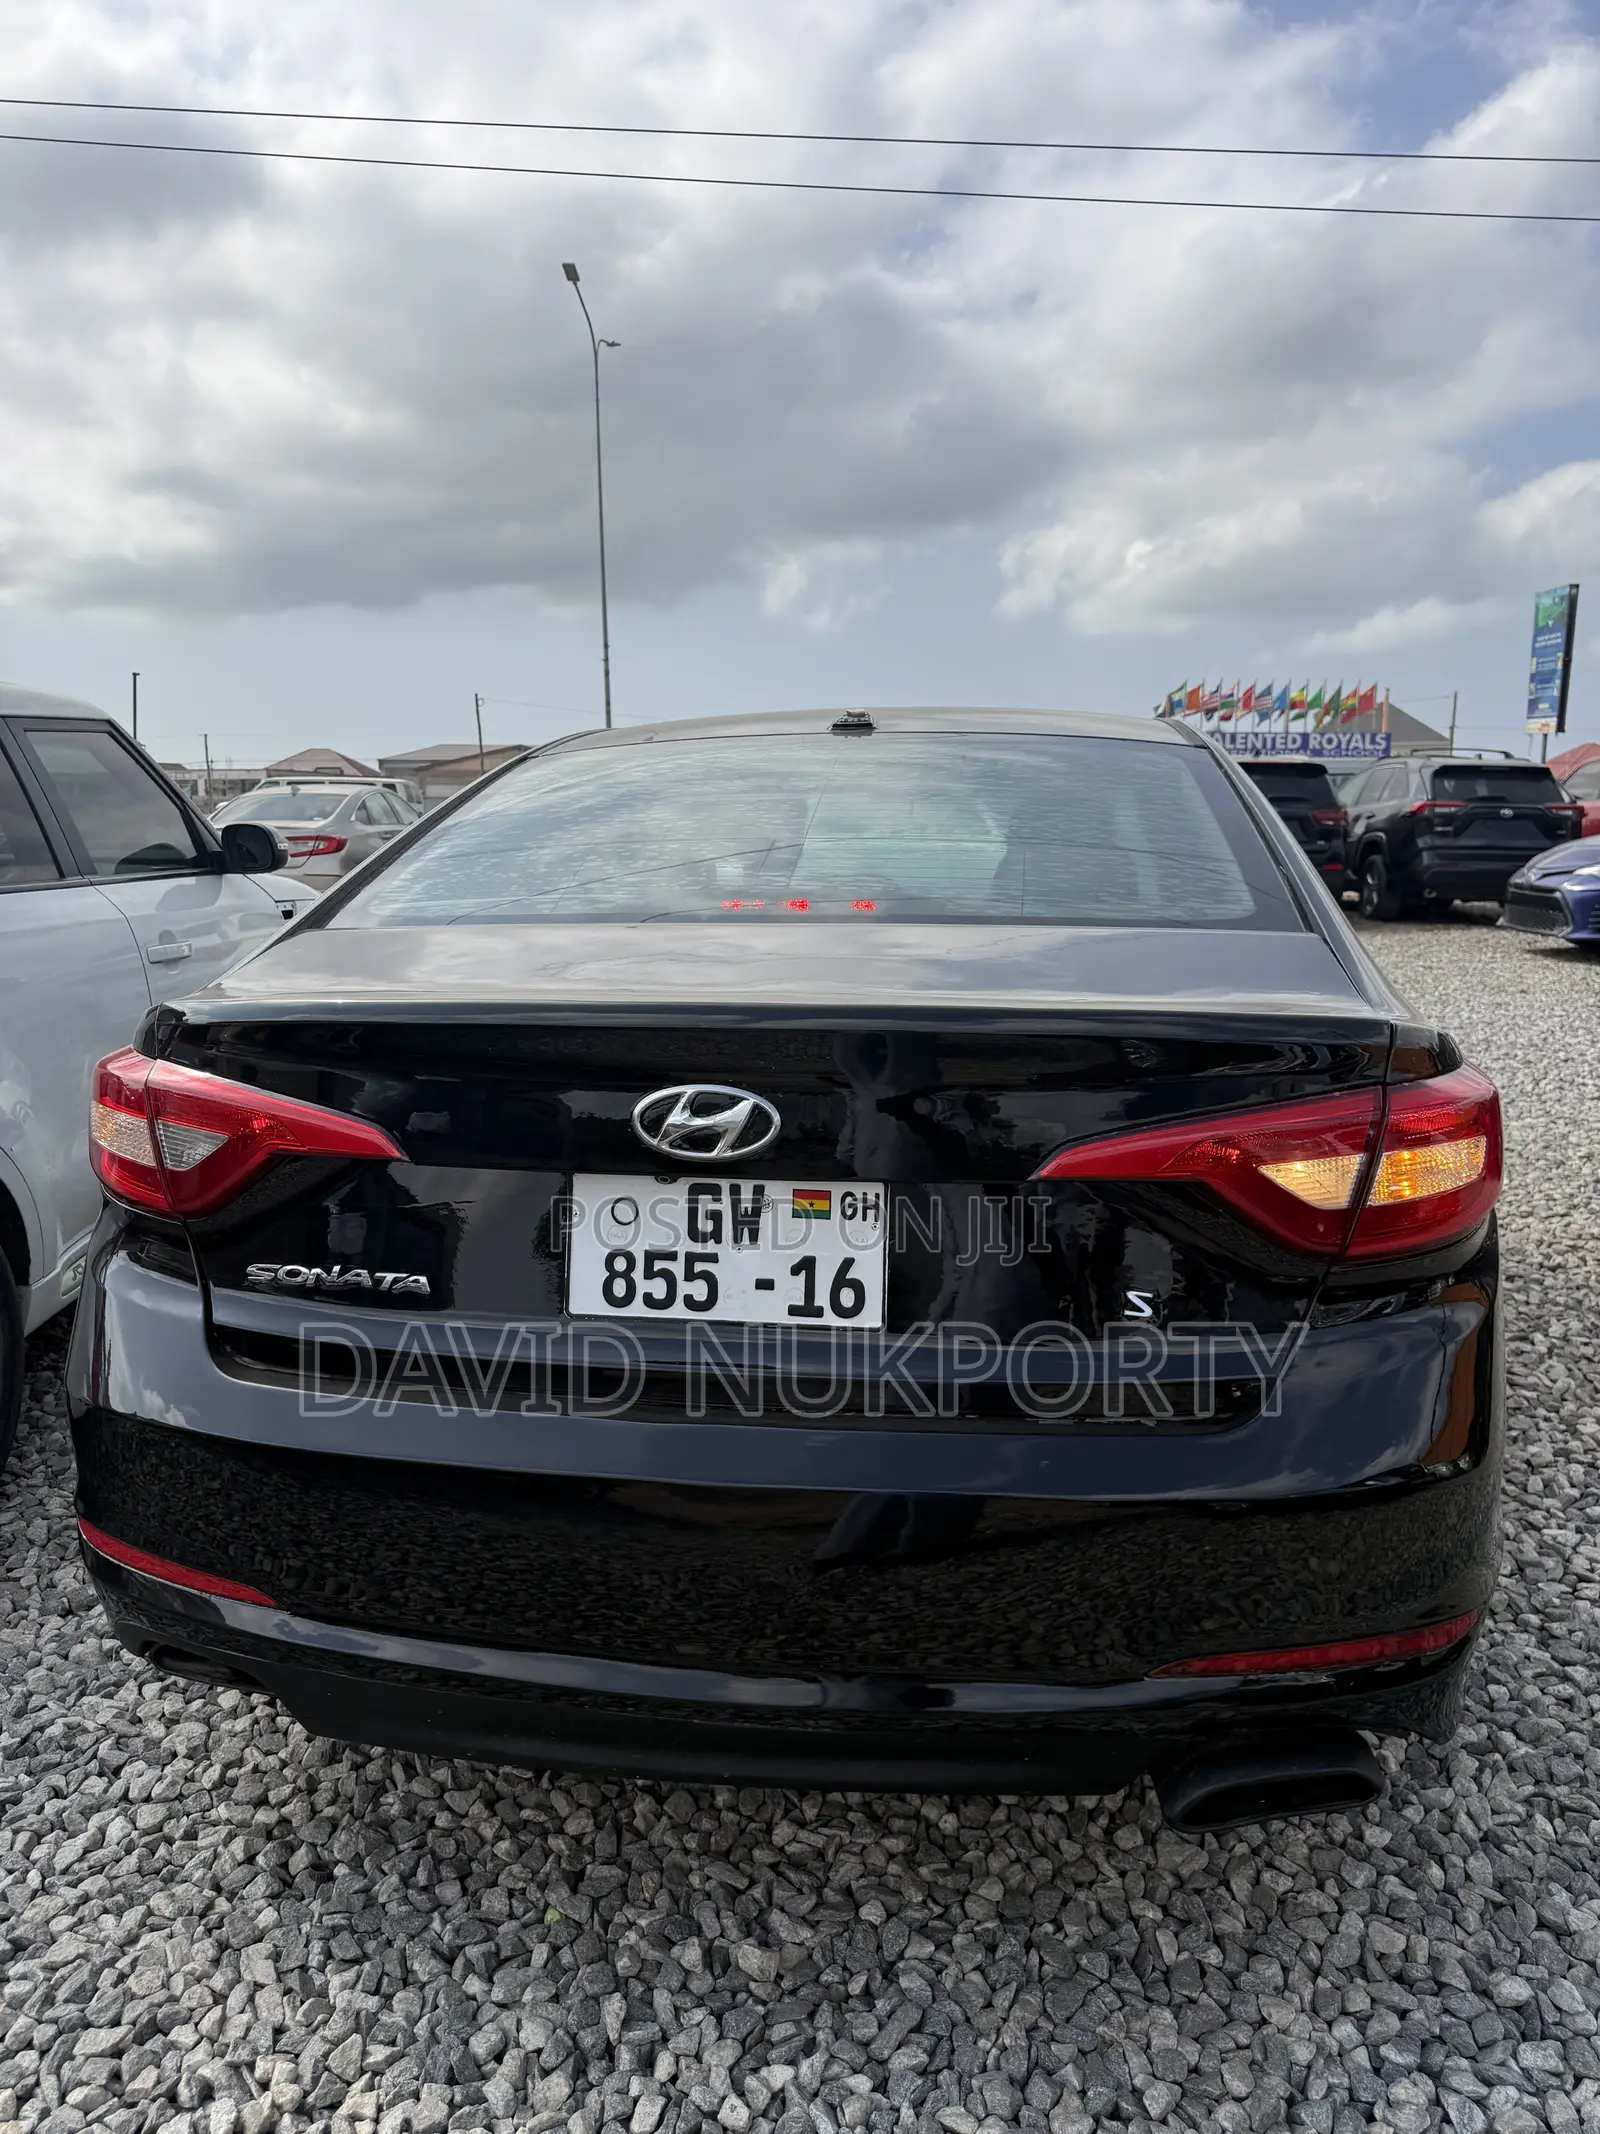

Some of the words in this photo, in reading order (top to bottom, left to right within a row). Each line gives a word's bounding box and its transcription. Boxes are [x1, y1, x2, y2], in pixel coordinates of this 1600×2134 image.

[1212, 732, 1302, 750] ALENTED
[1308, 732, 1388, 751] ROYALS
[1322, 749, 1386, 757] SCHOOL
[688, 1183, 765, 1245] GW
[840, 1191, 880, 1222] GH
[246, 1263, 431, 1295] SONATA
[602, 1249, 719, 1312] 855
[1124, 1290, 1153, 1317] S
